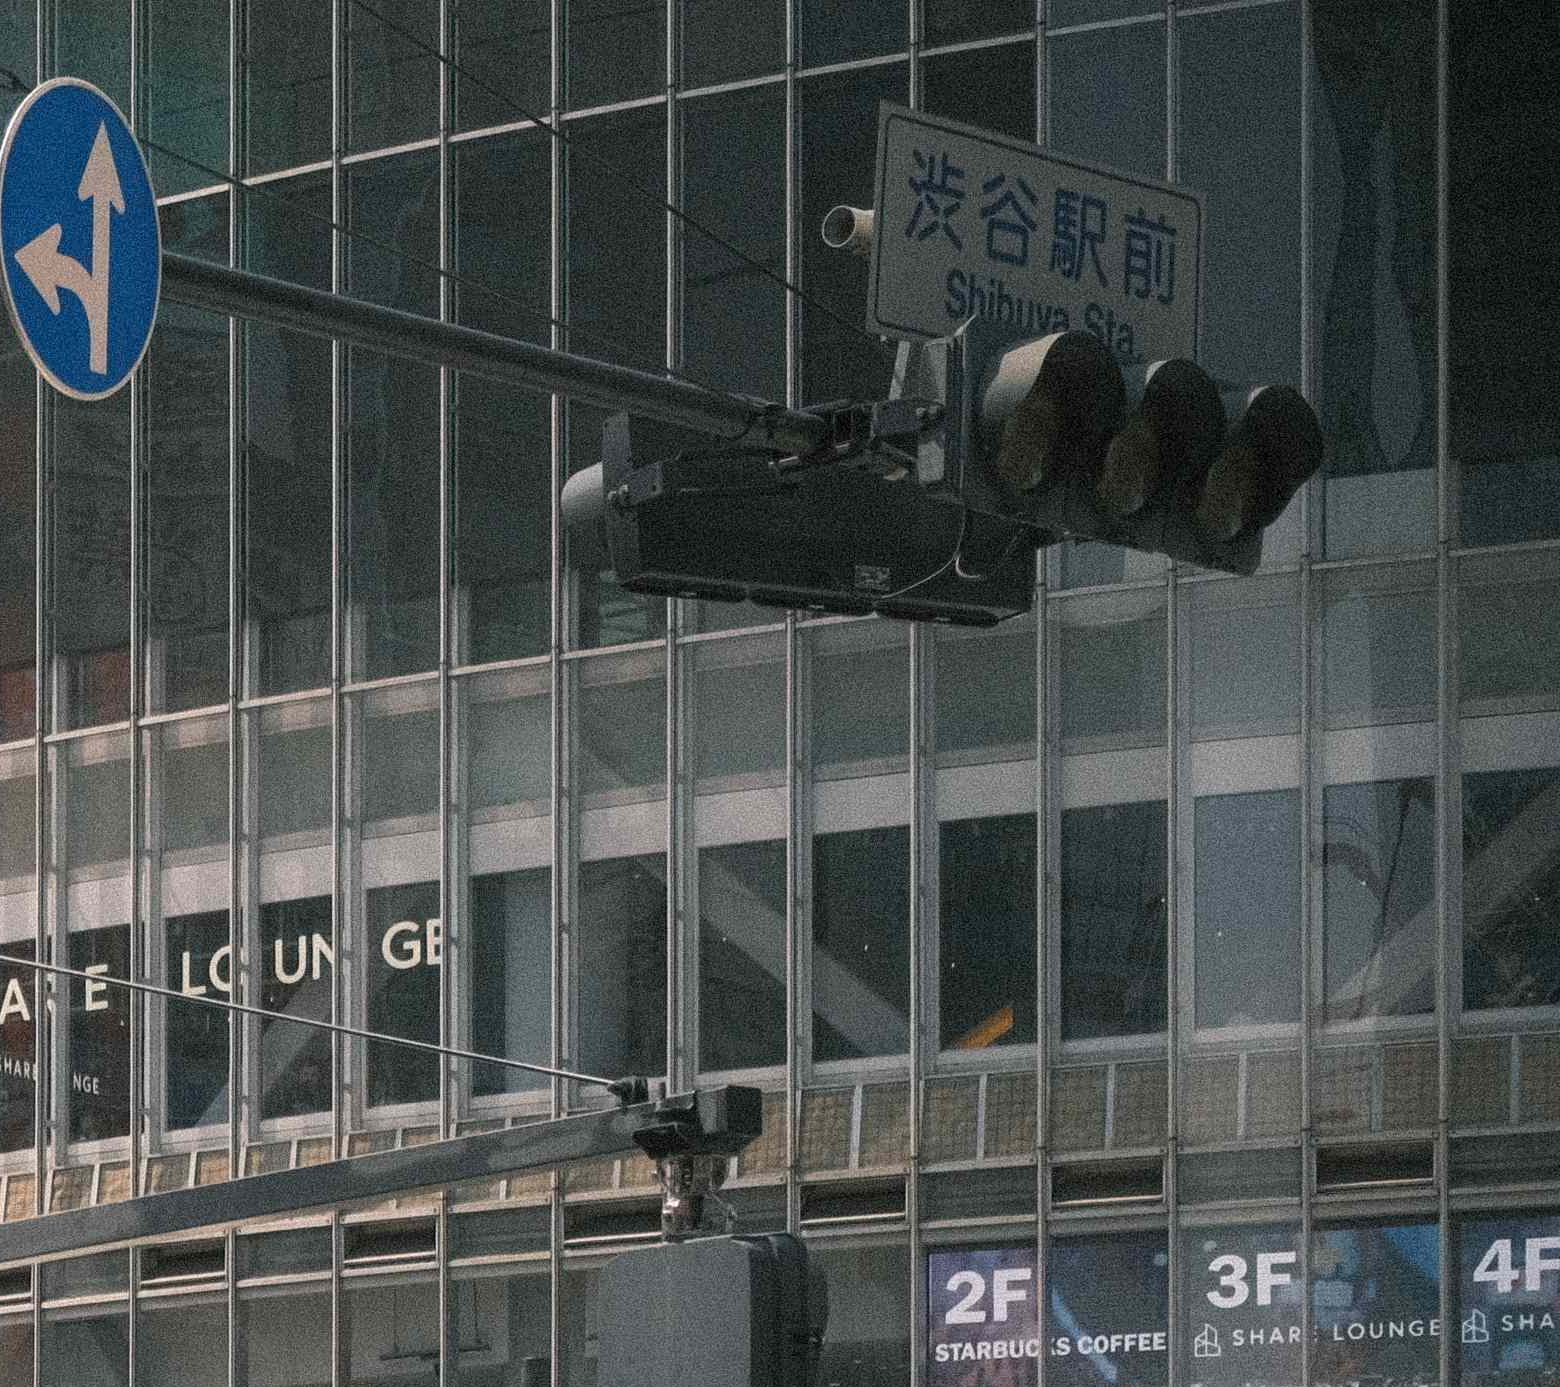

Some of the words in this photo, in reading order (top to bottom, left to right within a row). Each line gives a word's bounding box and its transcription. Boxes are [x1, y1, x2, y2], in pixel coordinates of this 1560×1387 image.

[905, 149, 1176, 304] 渋谷駅前
[945, 269, 1070, 333] Shibuya
[1206, 1252, 1297, 1309] 3F
[1472, 1236, 1560, 1293] 4F
[944, 1267, 1032, 1324] 2F
[1077, 1331, 1167, 1356] COFFEE
[1333, 1318, 1442, 1343] LOUNGE
